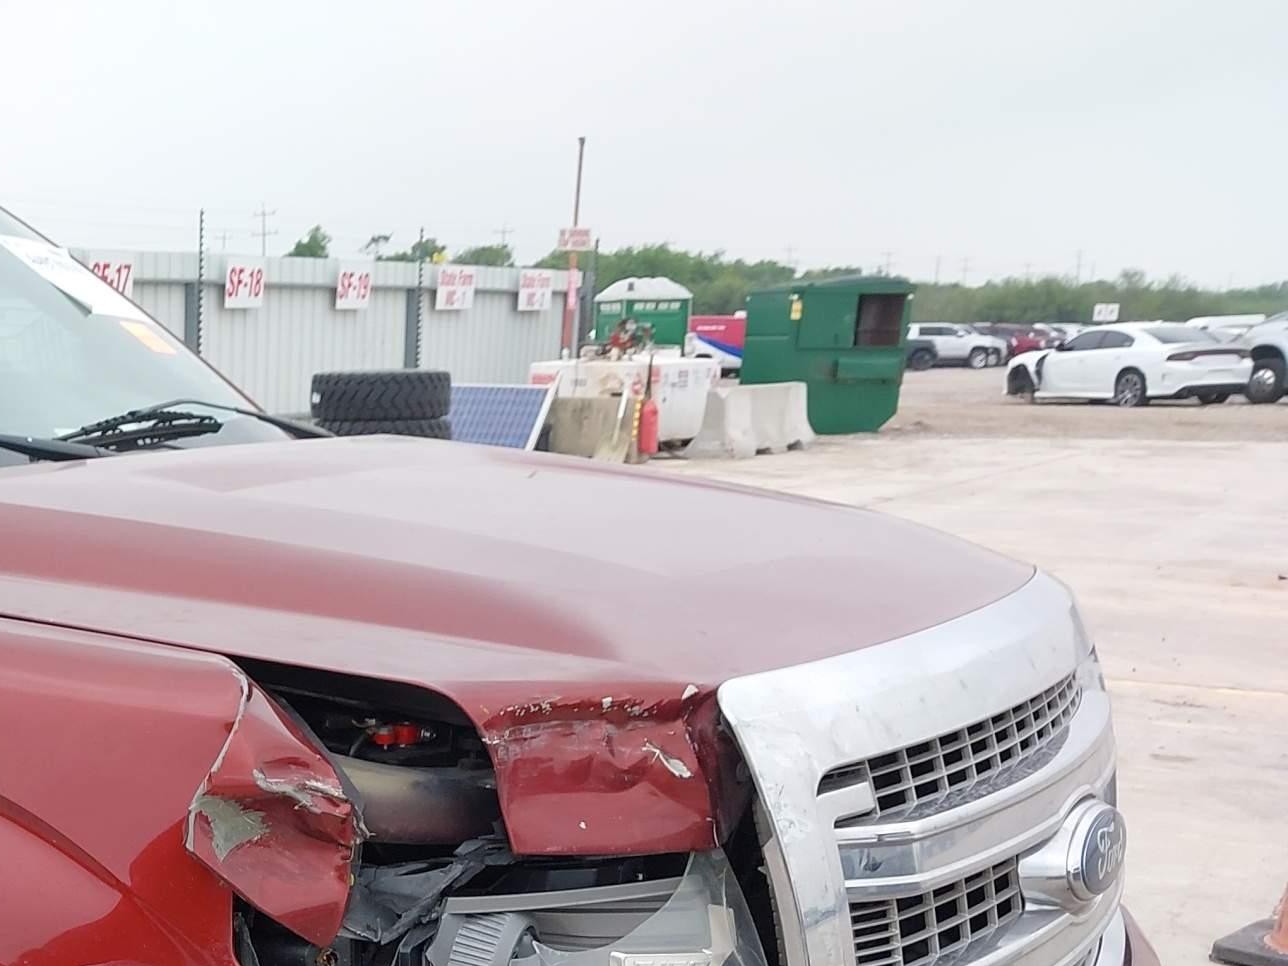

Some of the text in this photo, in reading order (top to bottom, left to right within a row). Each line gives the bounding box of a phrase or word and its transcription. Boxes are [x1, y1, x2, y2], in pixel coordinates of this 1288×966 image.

[227, 267, 264, 298] SF-18
[338, 271, 370, 299] SF-19
[1097, 820, 1124, 881] Ford
